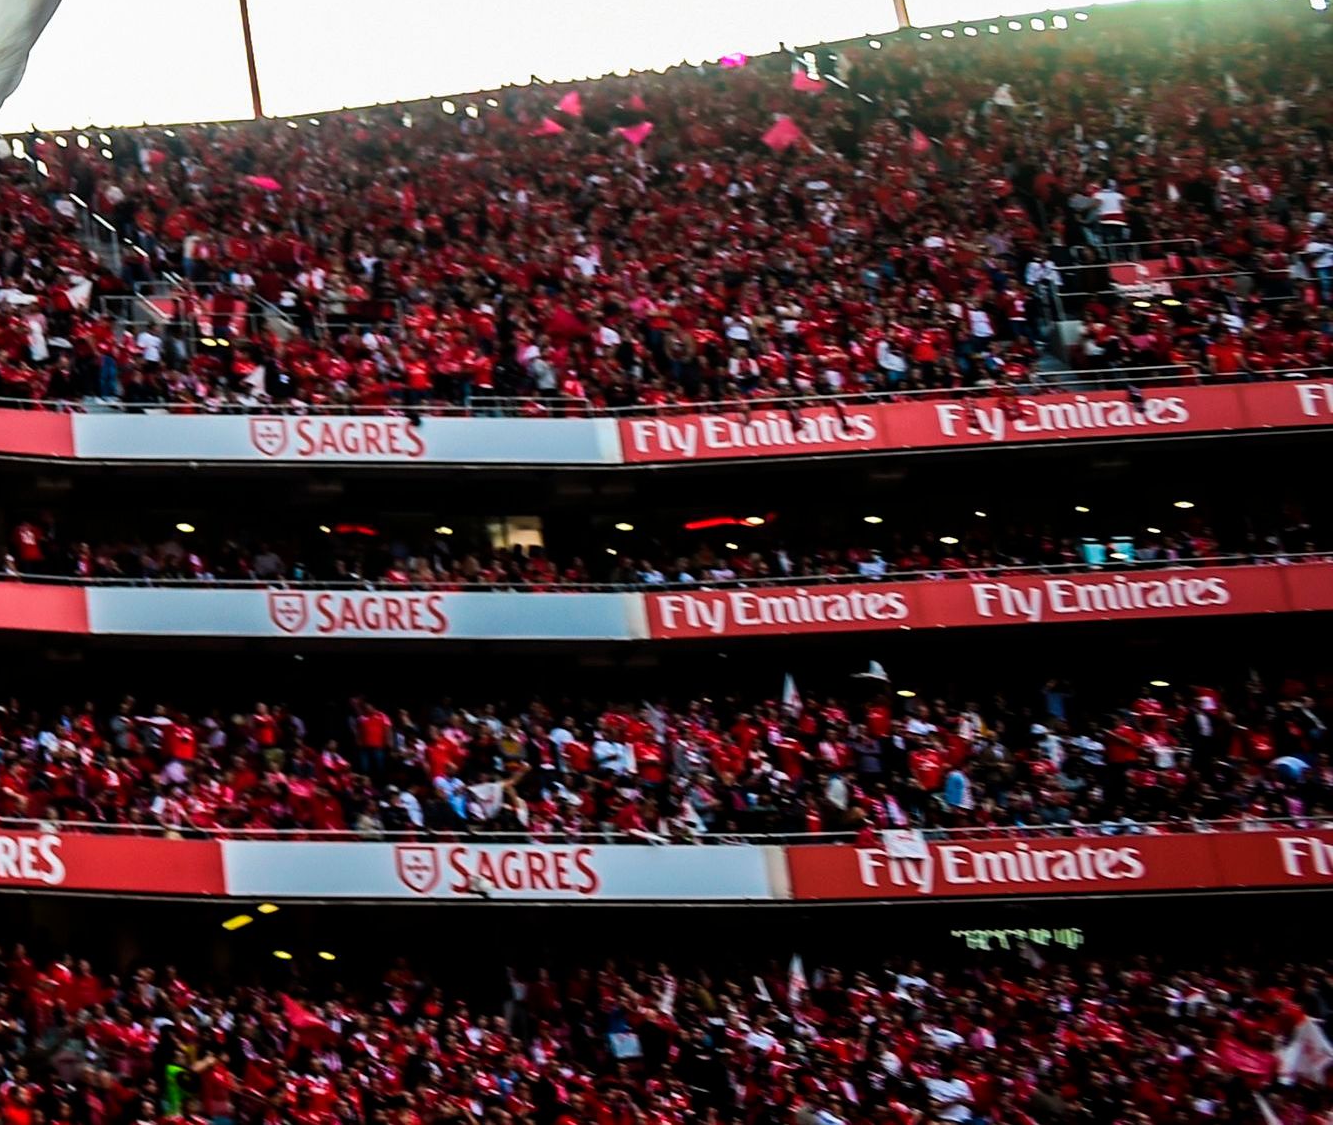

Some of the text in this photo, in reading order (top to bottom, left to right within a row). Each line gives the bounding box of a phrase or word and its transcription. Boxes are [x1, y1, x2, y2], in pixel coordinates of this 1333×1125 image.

[295, 418, 428, 458] SAGRES
[631, 419, 698, 458] Fly
[314, 593, 449, 635] SAGRES
[657, 588, 909, 634] Fly Emirates
[970, 575, 1231, 623] Fly Emirates
[448, 846, 601, 896] SAGRES
[935, 841, 1145, 884] Emirates
